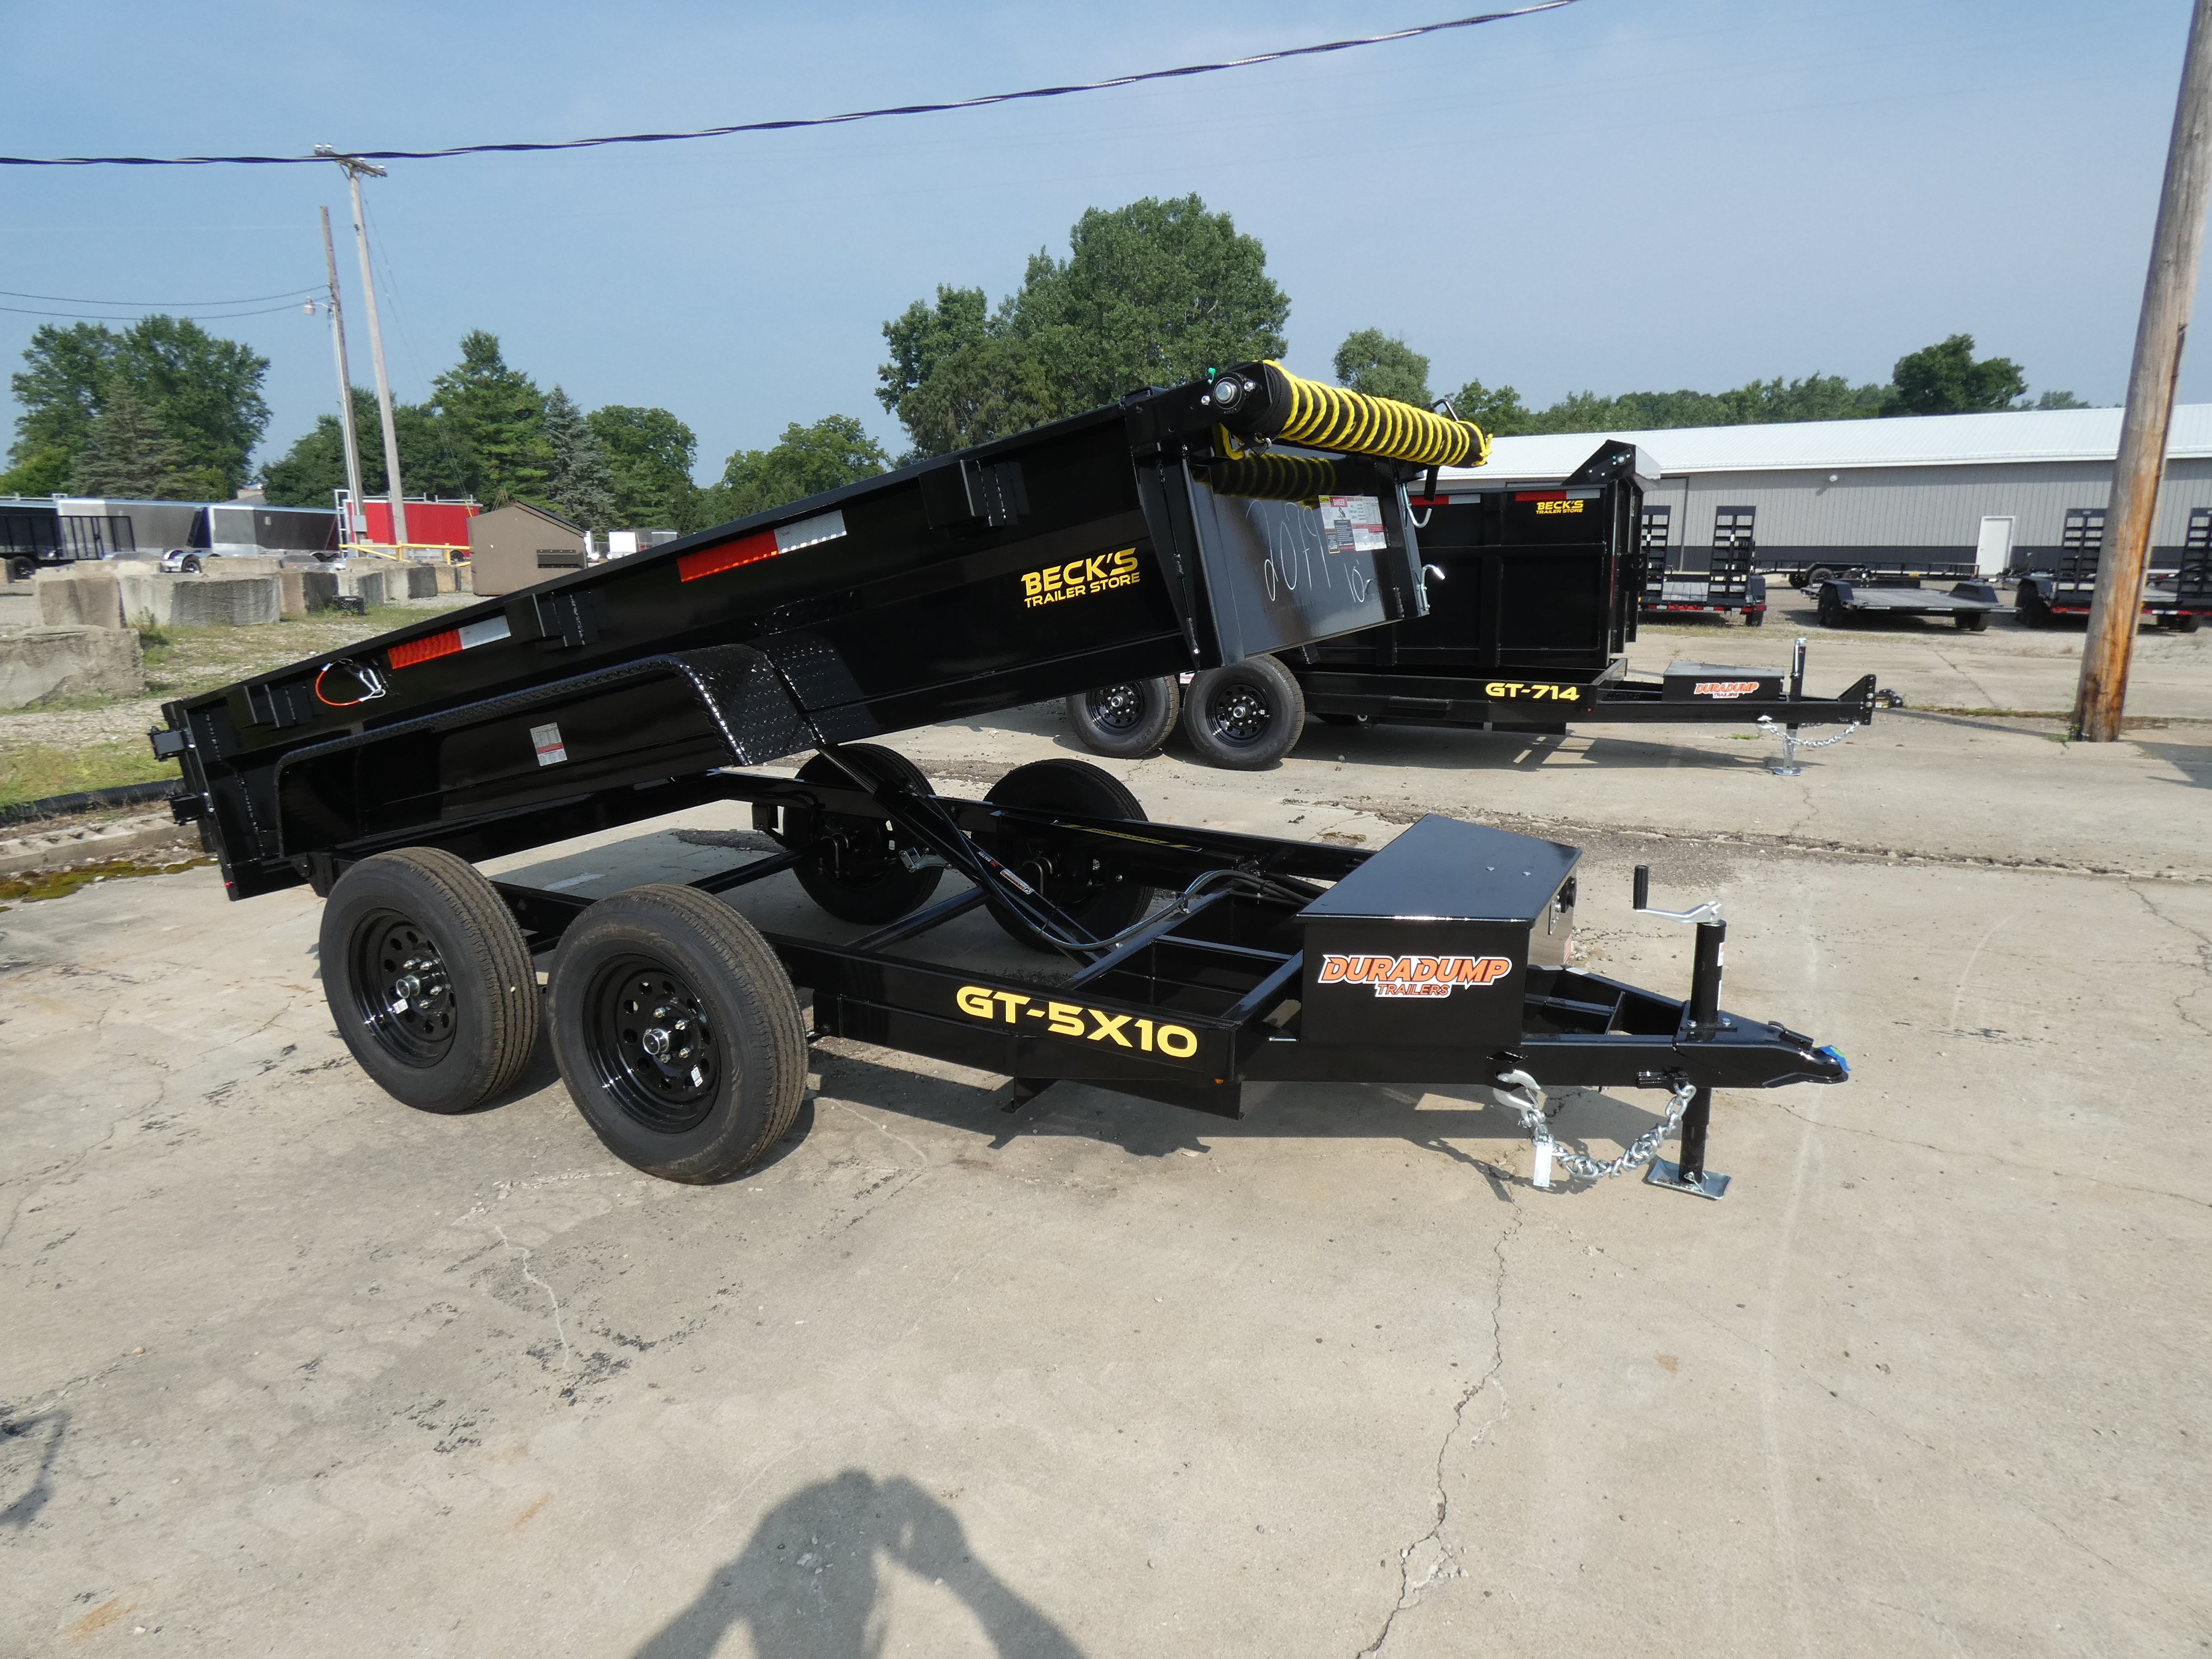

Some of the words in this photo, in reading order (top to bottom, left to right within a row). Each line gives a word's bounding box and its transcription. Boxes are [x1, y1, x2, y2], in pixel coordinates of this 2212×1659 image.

[1536, 500, 1584, 510] BECK'S
[1021, 547, 1138, 596] BECK'S
[1024, 585, 1086, 608] TRAILER
[1091, 572, 1140, 593] STORE
[1486, 682, 1580, 701] GT-714
[1695, 683, 1759, 693] DURADUMP
[1321, 956, 1510, 984] DURADUMP
[1378, 984, 1450, 995] TRAILERS
[956, 986, 1198, 1058] GT-5X10
